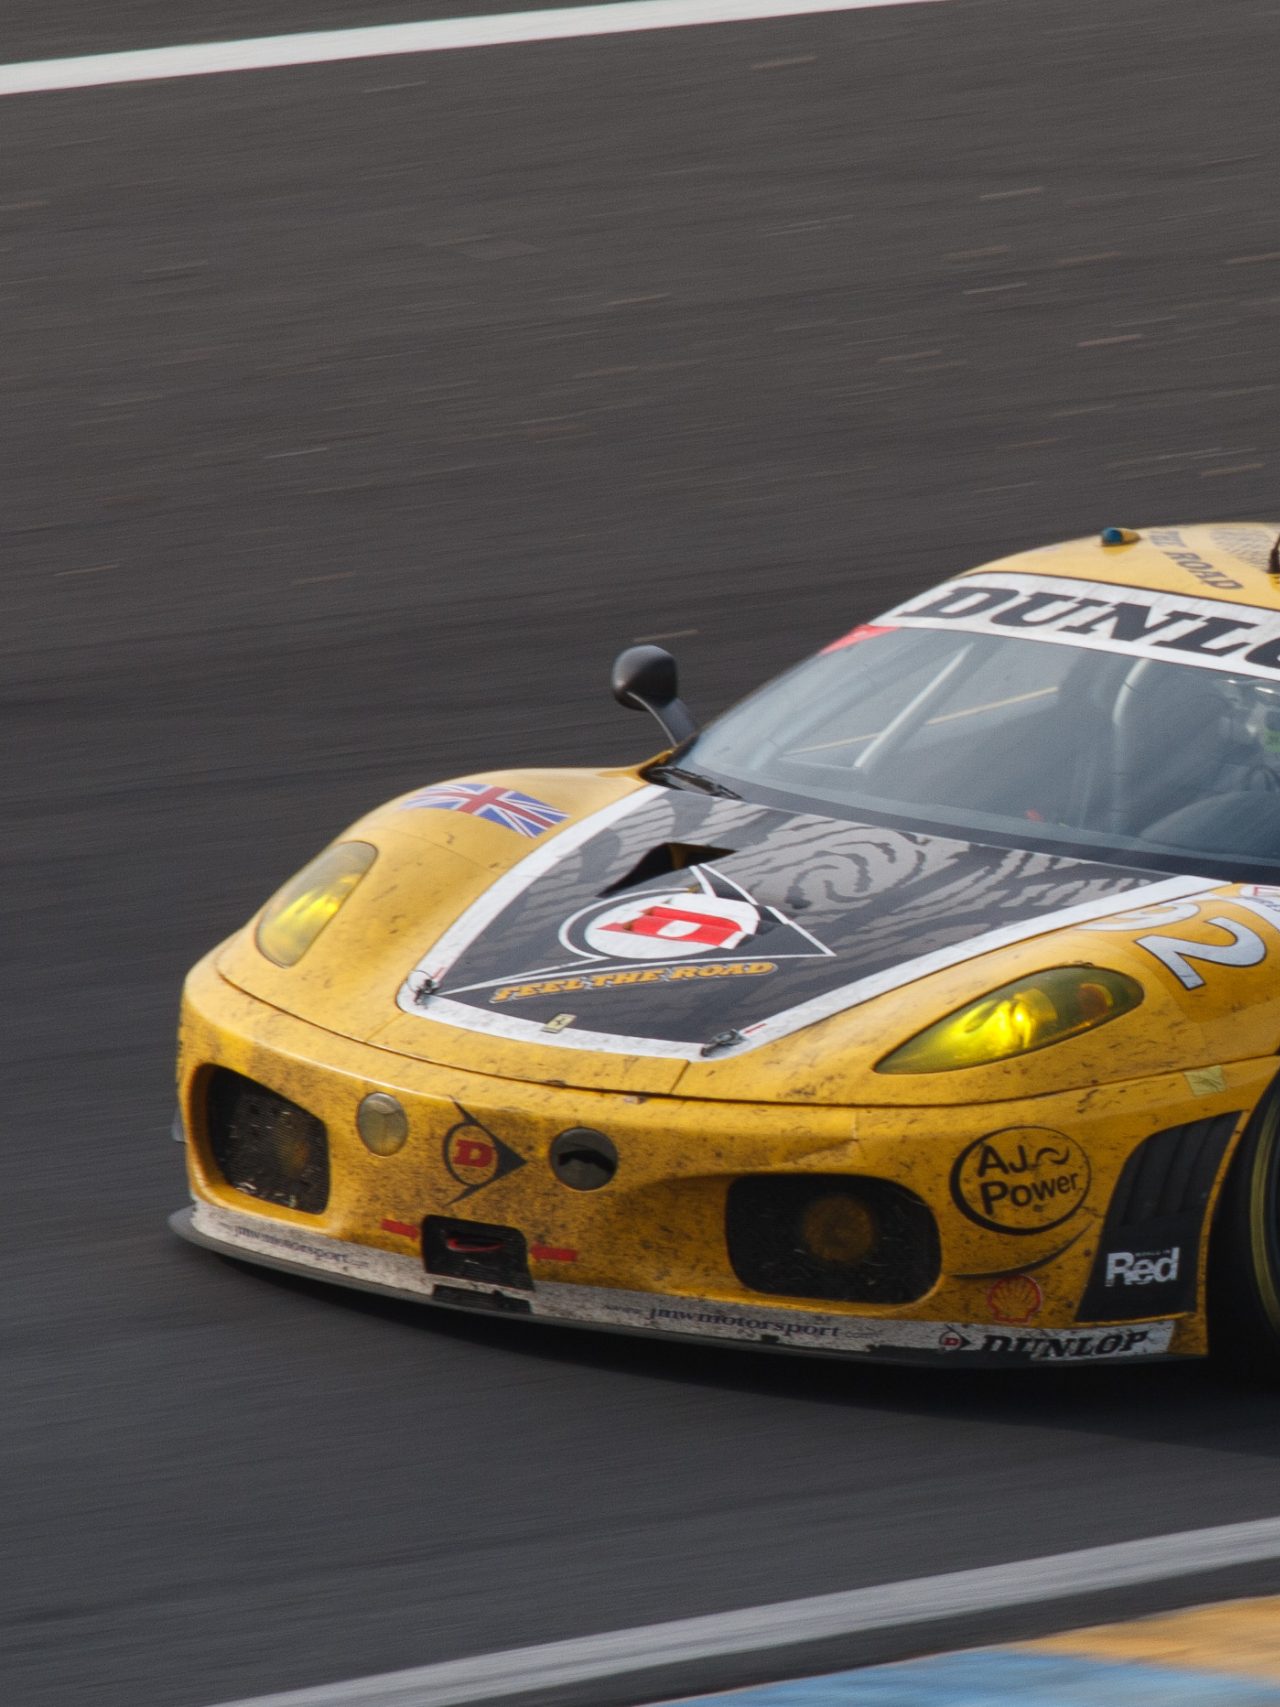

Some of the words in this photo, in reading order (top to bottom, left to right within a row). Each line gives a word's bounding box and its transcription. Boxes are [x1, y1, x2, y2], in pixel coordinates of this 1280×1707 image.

[1163, 552, 1244, 589] ROAD
[490, 978, 585, 1003] FEEL
[590, 968, 667, 988] THE
[669, 961, 777, 980] ROAD
[452, 1138, 493, 1168] D
[976, 1143, 1029, 1177] AJ
[979, 1169, 1079, 1216] Power
[1104, 1246, 1180, 1287] Red
[979, 1330, 1150, 1358] DUNLOP
